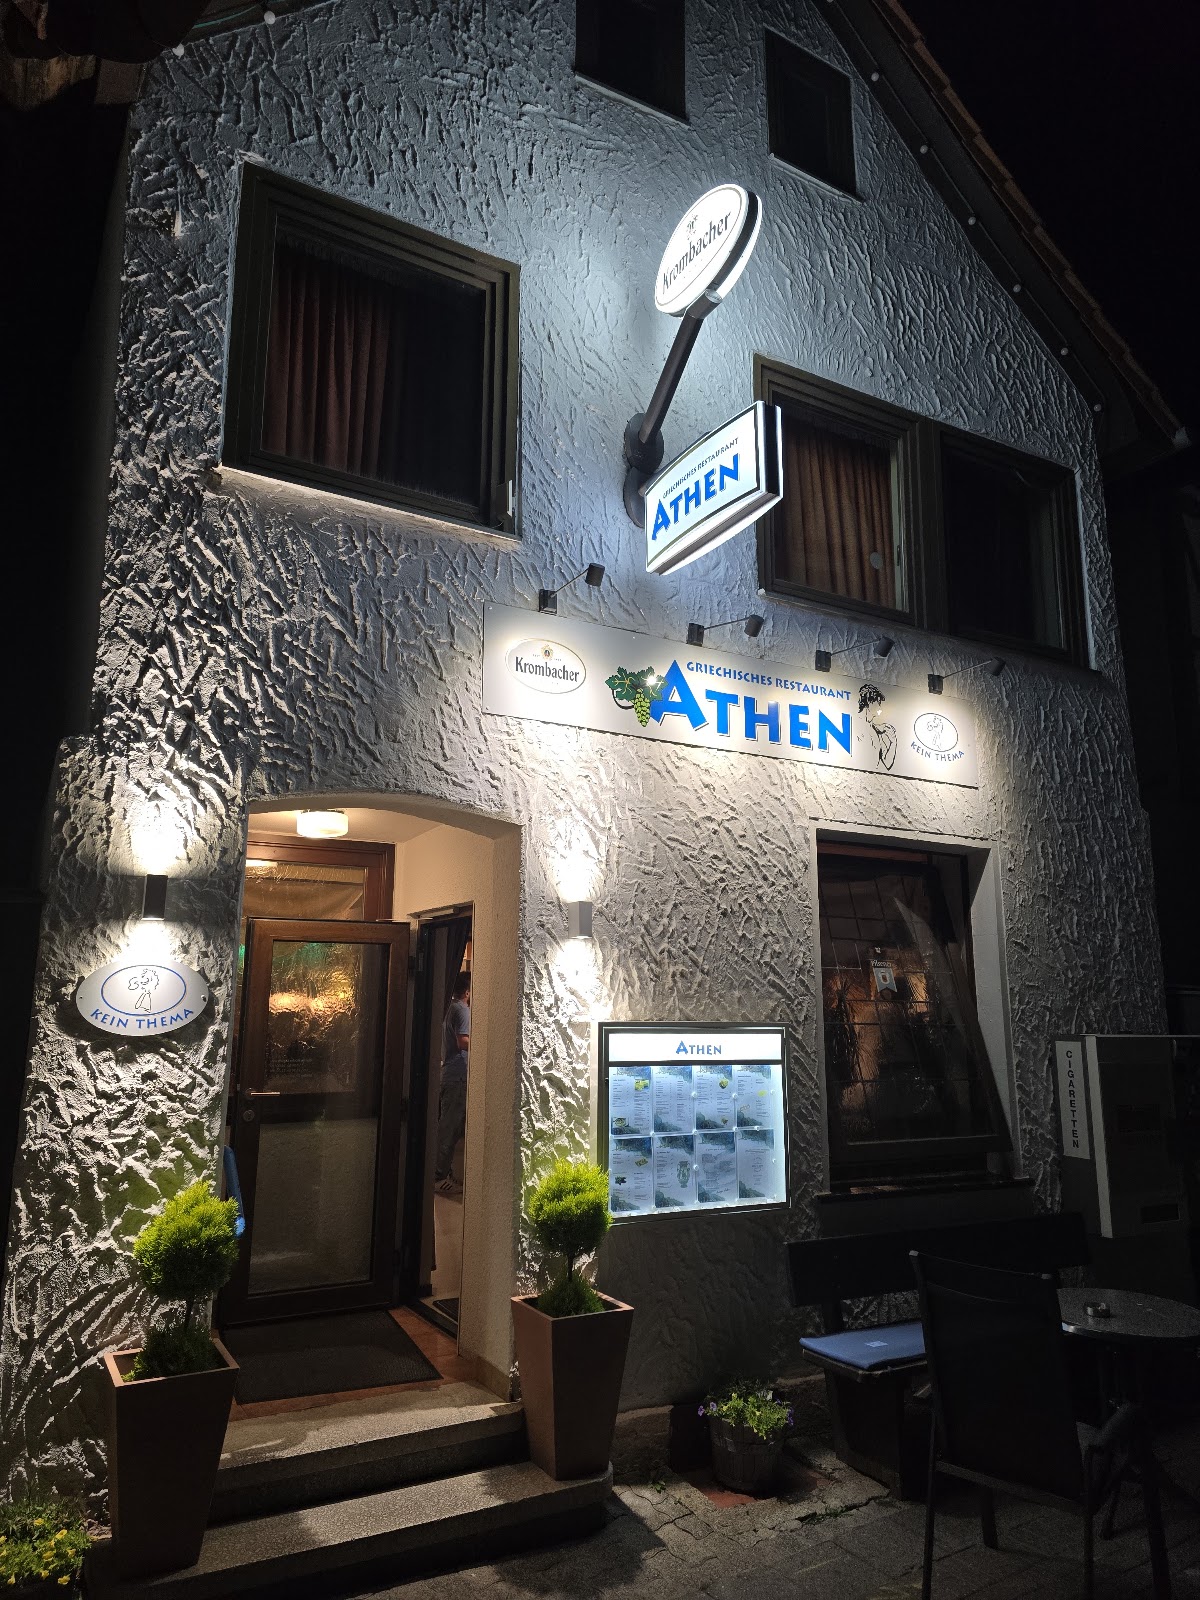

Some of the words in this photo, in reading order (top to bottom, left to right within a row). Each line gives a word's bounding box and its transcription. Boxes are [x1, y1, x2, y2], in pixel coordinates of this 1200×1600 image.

[662, 211, 731, 295] Krombacher
[698, 437, 739, 471] RESTAURANT
[652, 453, 740, 541] ATHEN
[515, 656, 579, 682] Krombacher
[686, 661, 773, 686] GRIECHISCHES
[775, 677, 851, 701] RESTAURANT
[650, 659, 852, 757] ATHEN
[911, 741, 931, 758] KEIN
[935, 751, 965, 762] THEMA
[90, 1008, 129, 1029] KEIN
[136, 1008, 194, 1029] THEMA
[676, 1040, 722, 1055] ATHEN
[1065, 1050, 1079, 1149] CIGARETTEN
